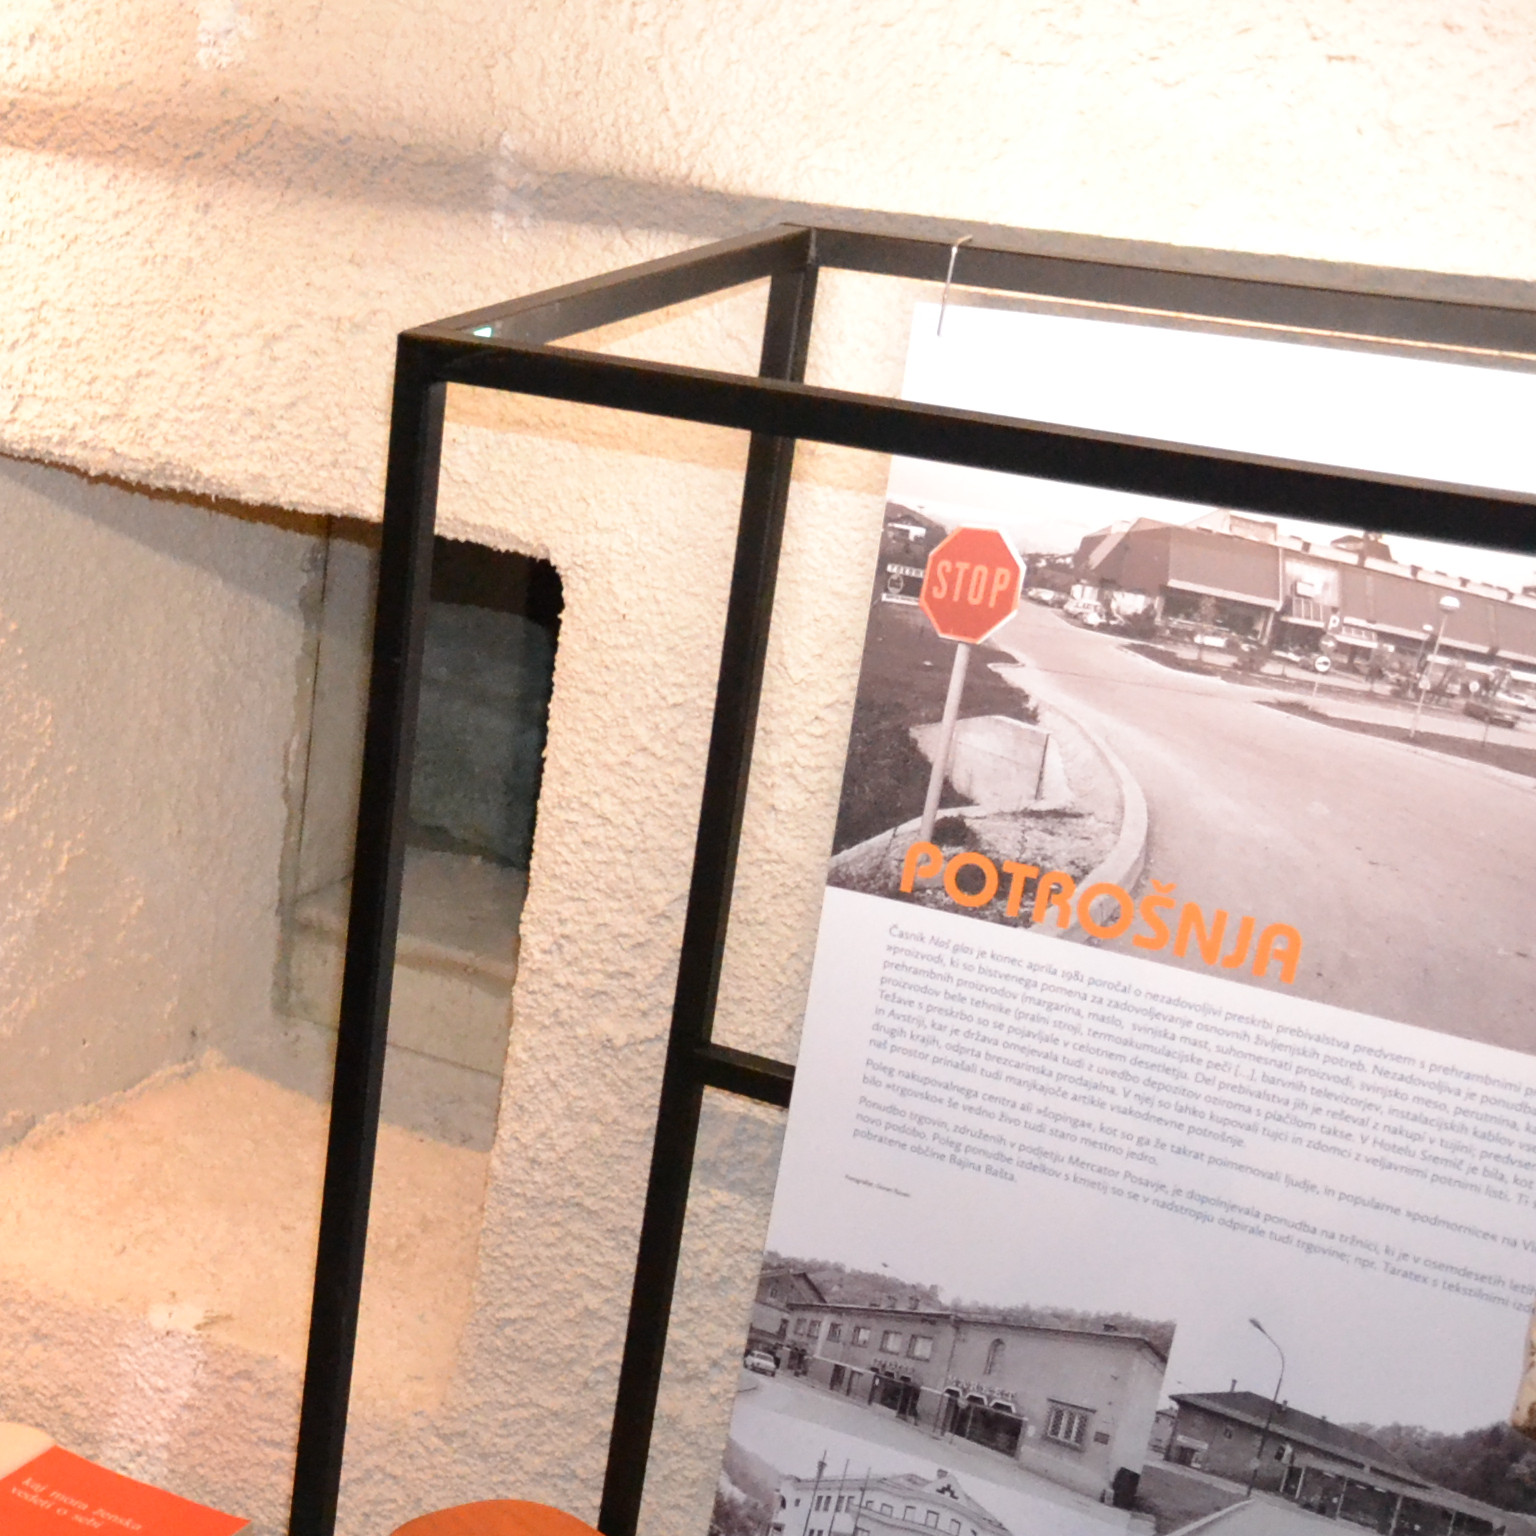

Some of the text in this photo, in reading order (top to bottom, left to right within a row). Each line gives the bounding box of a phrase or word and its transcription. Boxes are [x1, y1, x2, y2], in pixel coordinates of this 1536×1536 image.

[932, 559, 1011, 609] STOP
[898, 840, 1304, 984] POTROŠNJA
[878, 988, 914, 1007] Težave
[925, 1002, 973, 1022] preskrbo
[1007, 1024, 1059, 1045] pojavljale
[1072, 1041, 1126, 1063] celotnem
[1194, 1071, 1215, 1086] Del
[1218, 1080, 1289, 1106] prebivalstva
[1326, 1108, 1369, 1127] reševal
[1383, 1123, 1425, 1144] nakupi
[879, 974, 940, 997] proizvodov
[944, 988, 966, 1004] bele
[970, 995, 1010, 1016] tehnike
[1087, 1026, 1202, 1066] termoakumulacijske
[1206, 1059, 1231, 1073] peči
[1261, 1071, 1306, 1093] barvnih
[1388, 1104, 1469, 1135] instalacijskih
[1473, 1126, 1514, 1147] kablov
[882, 958, 953, 984] prehrambnih
[956, 977, 1017, 1000] proizvodov
[1131, 1022, 1175, 1041] svinjska
[1215, 1044, 1292, 1071] suhomesnati
[1359, 1081, 1408, 1101] svinjsko
[888, 922, 925, 943] Časnik
[929, 934, 950, 949] Naš
[952, 942, 973, 955] glas
[990, 950, 1022, 968] konec
[1027, 961, 1057, 976] aprila
[1087, 976, 1131, 995] poročal
[1145, 991, 1222, 1018] nezadovoljivi
[1224, 1011, 1273, 1031] preskrbi
[1276, 1024, 1349, 1050] prebivalstva
[1353, 1043, 1415, 1066] predvsem
[1429, 1062, 1521, 1093] prehrambnimi
[978, 964, 1037, 989] bistvenega
[1041, 982, 1087, 1001] pomena
[1107, 999, 1192, 1029] zadovoljevanje
[1196, 1021, 1250, 1043] osnovnih
[1254, 1033, 1319, 1060] življenjskih
[1372, 1063, 1461, 1097] Nezadovoljiva
[862, 1072, 882, 1087] bilo
[962, 1102, 995, 1119] vedno
[998, 1110, 1020, 1126] živo
[1024, 1117, 1046, 1133] tudi
[1049, 1126, 1076, 1142] staro
[1080, 1136, 1123, 1155] mestno
[865, 1056, 894, 1077] Poleg
[898, 1068, 978, 1098] nakupovalnega
[982, 1091, 1016, 1108] centra
[1170, 1141, 1204, 1161] takrat
[1207, 1154, 1281, 1182] poimenovali
[869, 1037, 887, 1049] naš
[890, 1042, 929, 1060] prostor
[930, 1054, 977, 1073] prinašali
[980, 1065, 1002, 1080] tudi
[1005, 1074, 1068, 1098] manjkajoče
[1071, 1092, 1106, 1109] artikle
[1110, 1102, 1184, 1130] vsakodnevne
[872, 1019, 906, 1037] drugih
[945, 1040, 981, 1058] odprta
[984, 1049, 1052, 1077] brezcarinska
[1133, 1091, 1155, 1108] njej
[1174, 1100, 1205, 1119] lahko
[1209, 1110, 1259, 1133] kupovali
[1262, 1124, 1289, 1141] tujci
[1306, 1138, 1351, 1158] zdomci
[1363, 1154, 1427, 1179] veljavnimi
[1430, 1172, 1482, 1194] potnimi
[963, 1027, 998, 1046] država
[1002, 1040, 1058, 1062] omejevala
[1062, 1053, 1085, 1069] tudi
[1097, 1065, 1139, 1084] uvedbo
[1143, 1075, 1200, 1100] depozitov
[1204, 1093, 1252, 1114] oziroma
[1264, 1109, 1316, 1131] plačilom
[1372, 1136, 1415, 1158] Hotelu
[856, 1112, 881, 1126] novo
[932, 1131, 961, 1152] Poleg
[964, 1143, 1013, 1164] ponudbe
[1016, 1156, 1061, 1178] izdelkov
[1073, 1172, 1109, 1195] kmetij
[1152, 1197, 1213, 1223] nadstropju
[1218, 1215, 1265, 1237] odpirale
[1269, 1228, 1293, 1245] tudi
[1383, 1261, 1428, 1285] Taratex
[1442, 1278, 1509, 1308] tekstilnimi
[859, 1093, 906, 1117] Ponudbo
[953, 1122, 1006, 1145] združenih
[1018, 1141, 1064, 1163] podjetju
[1068, 1153, 1119, 1178] Mercator
[1185, 1187, 1260, 1219] dopolnjevala
[1423, 1257, 1505, 1289] osemdesetih
[910, 1143, 945, 1161] občine
[949, 1153, 981, 1172] Bajina
[10, 1486, 105, 1530] vedeti o sebi
[21, 1476, 143, 1532] kaj mora ženska
